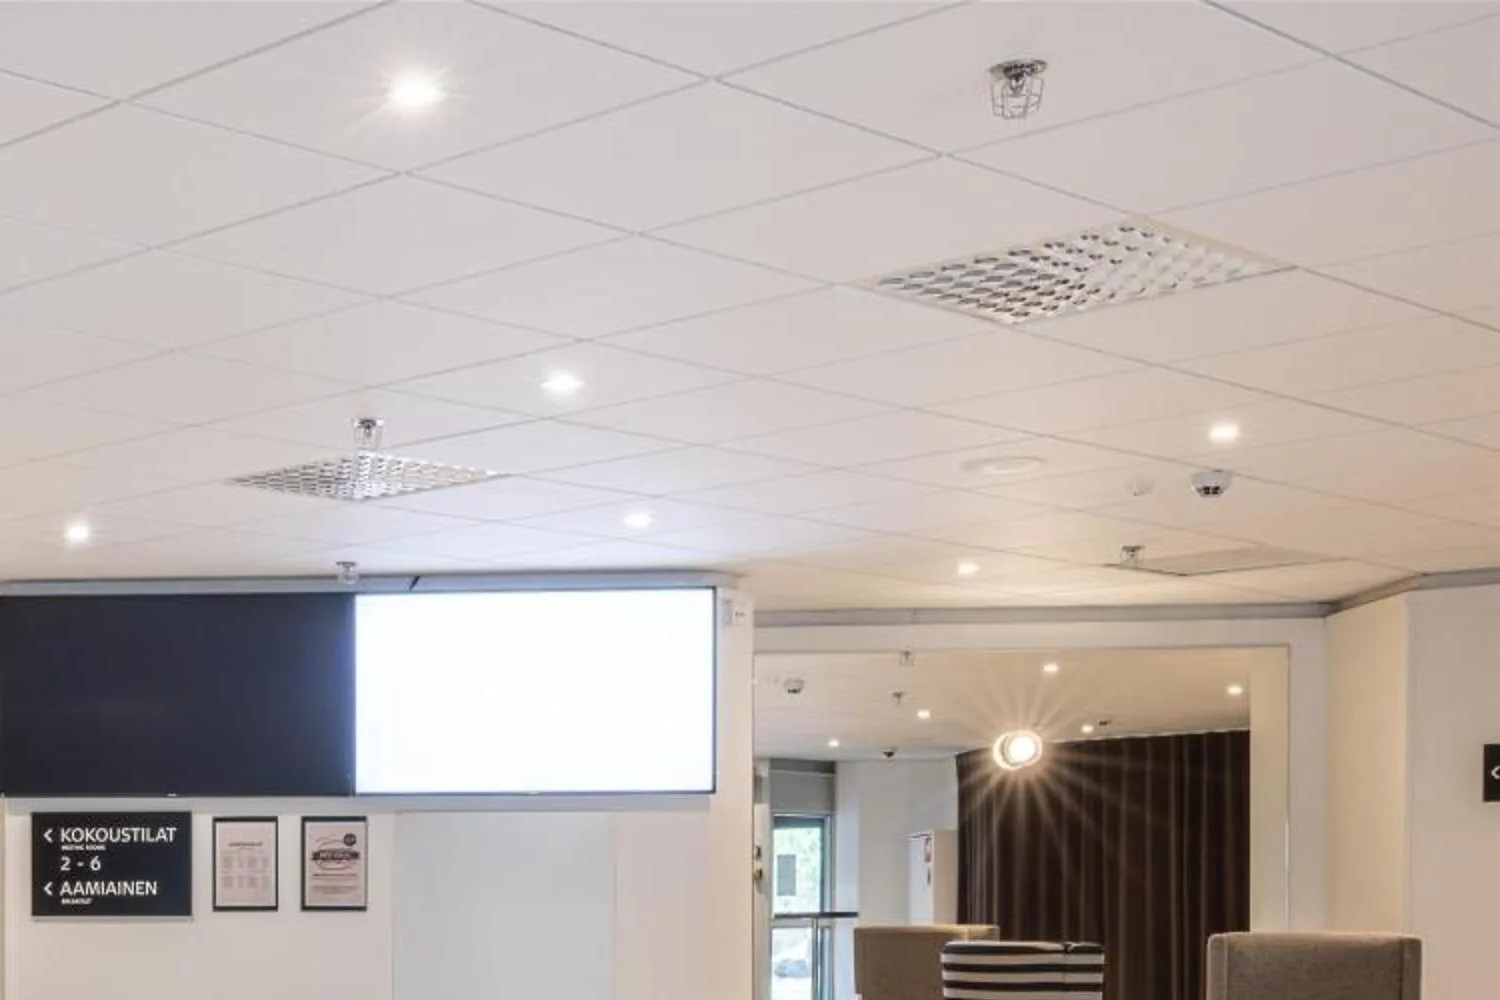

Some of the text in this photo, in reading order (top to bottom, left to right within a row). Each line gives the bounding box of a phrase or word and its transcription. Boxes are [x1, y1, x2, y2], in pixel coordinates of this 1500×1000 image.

[60, 827, 177, 843] KOKOUSTILAT
[60, 855, 71, 871] 2
[89, 855, 101, 871] 6
[59, 880, 158, 896] AAMIAINEN
